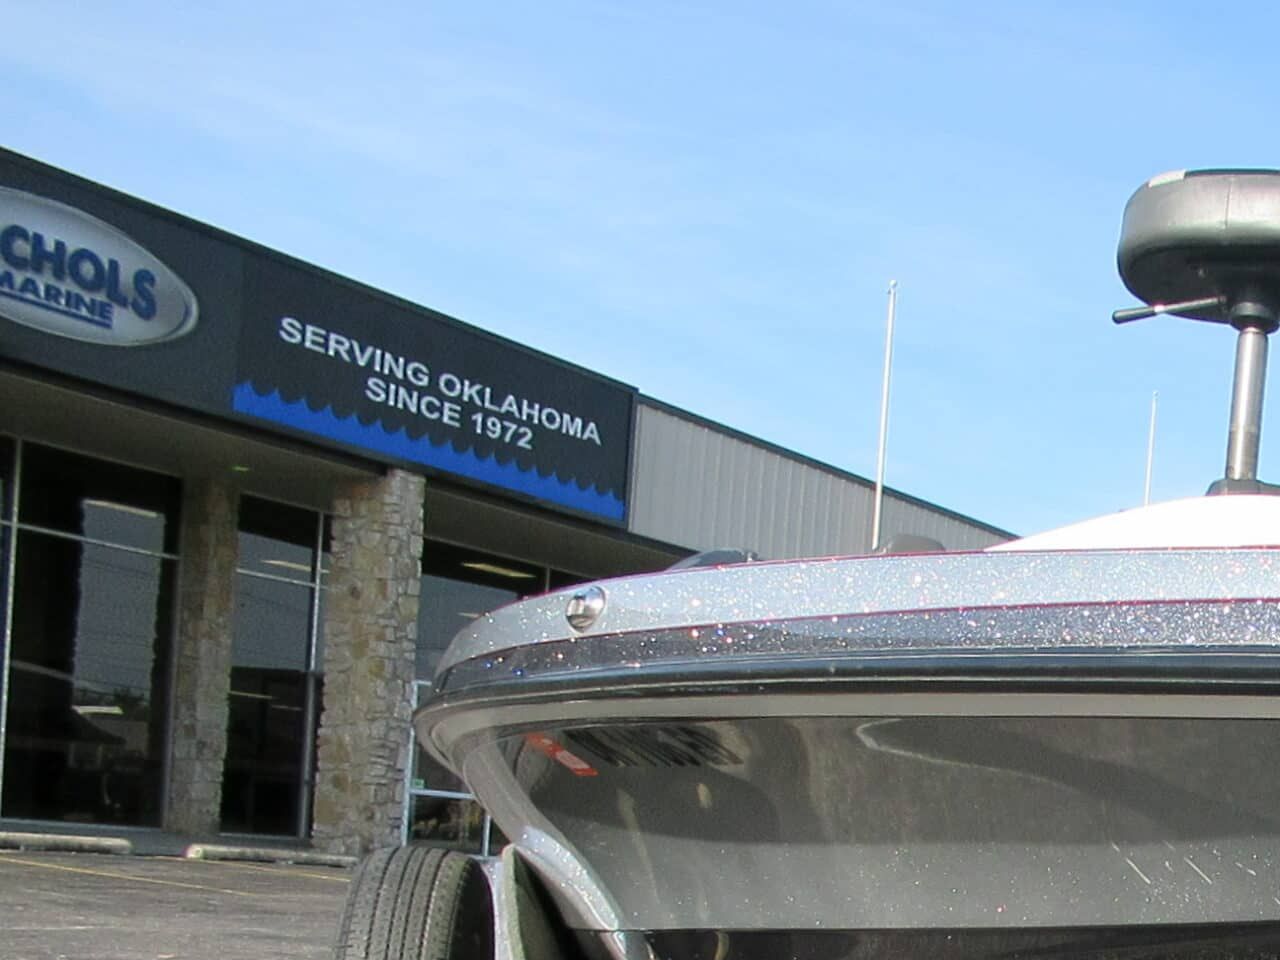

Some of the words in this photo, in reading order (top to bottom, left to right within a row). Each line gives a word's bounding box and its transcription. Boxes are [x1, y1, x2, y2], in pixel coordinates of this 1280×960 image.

[0, 224, 157, 321] CHOLS
[279, 317, 429, 387] SERVING
[438, 373, 602, 445] OKLAHOMA
[364, 377, 462, 427] SINCE
[471, 412, 533, 449] 1972
